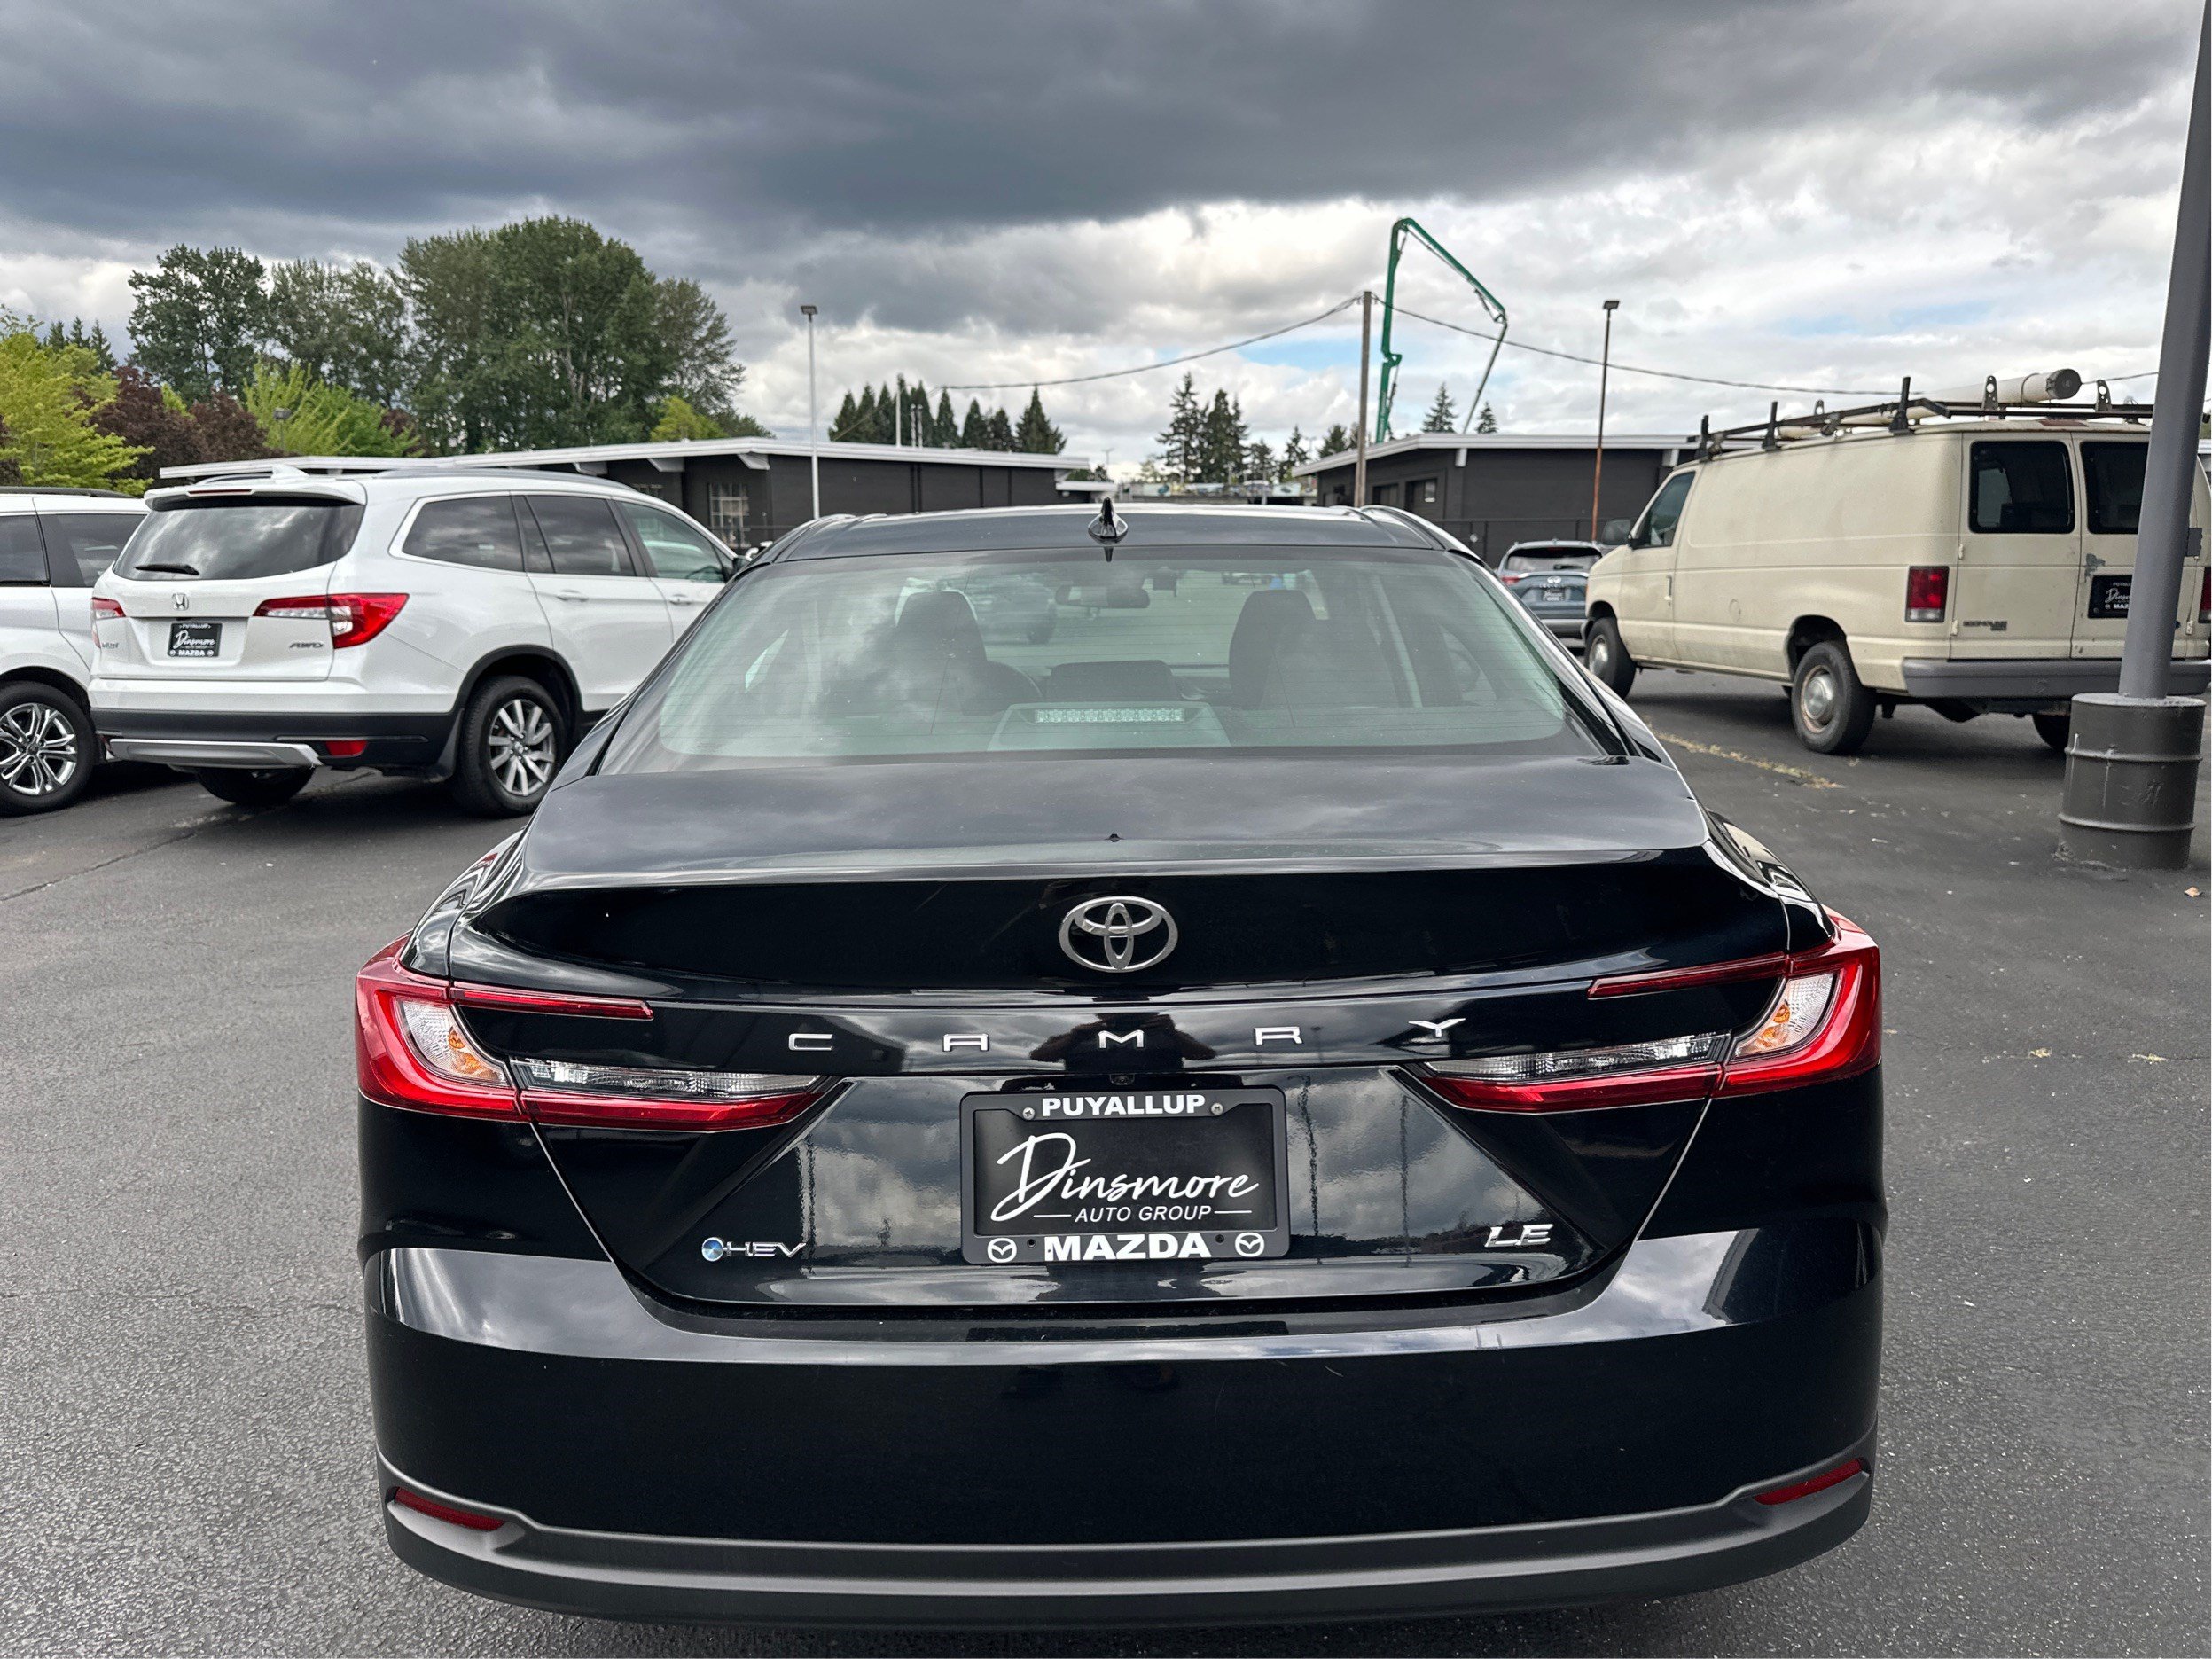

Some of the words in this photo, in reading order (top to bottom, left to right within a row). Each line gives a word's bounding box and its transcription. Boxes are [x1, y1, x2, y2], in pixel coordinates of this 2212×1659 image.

[788, 1017, 1466, 1053] CAMRY
[1042, 1094, 1206, 1117] PUYALLUP
[990, 1132, 1259, 1222] Dinsmore
[1075, 1206, 1132, 1223] AUTO
[1138, 1205, 1212, 1221] GROUP
[1043, 1233, 1212, 1262] MAZDA
[1484, 1224, 1554, 1248] LE
[726, 1241, 807, 1257] HEV
